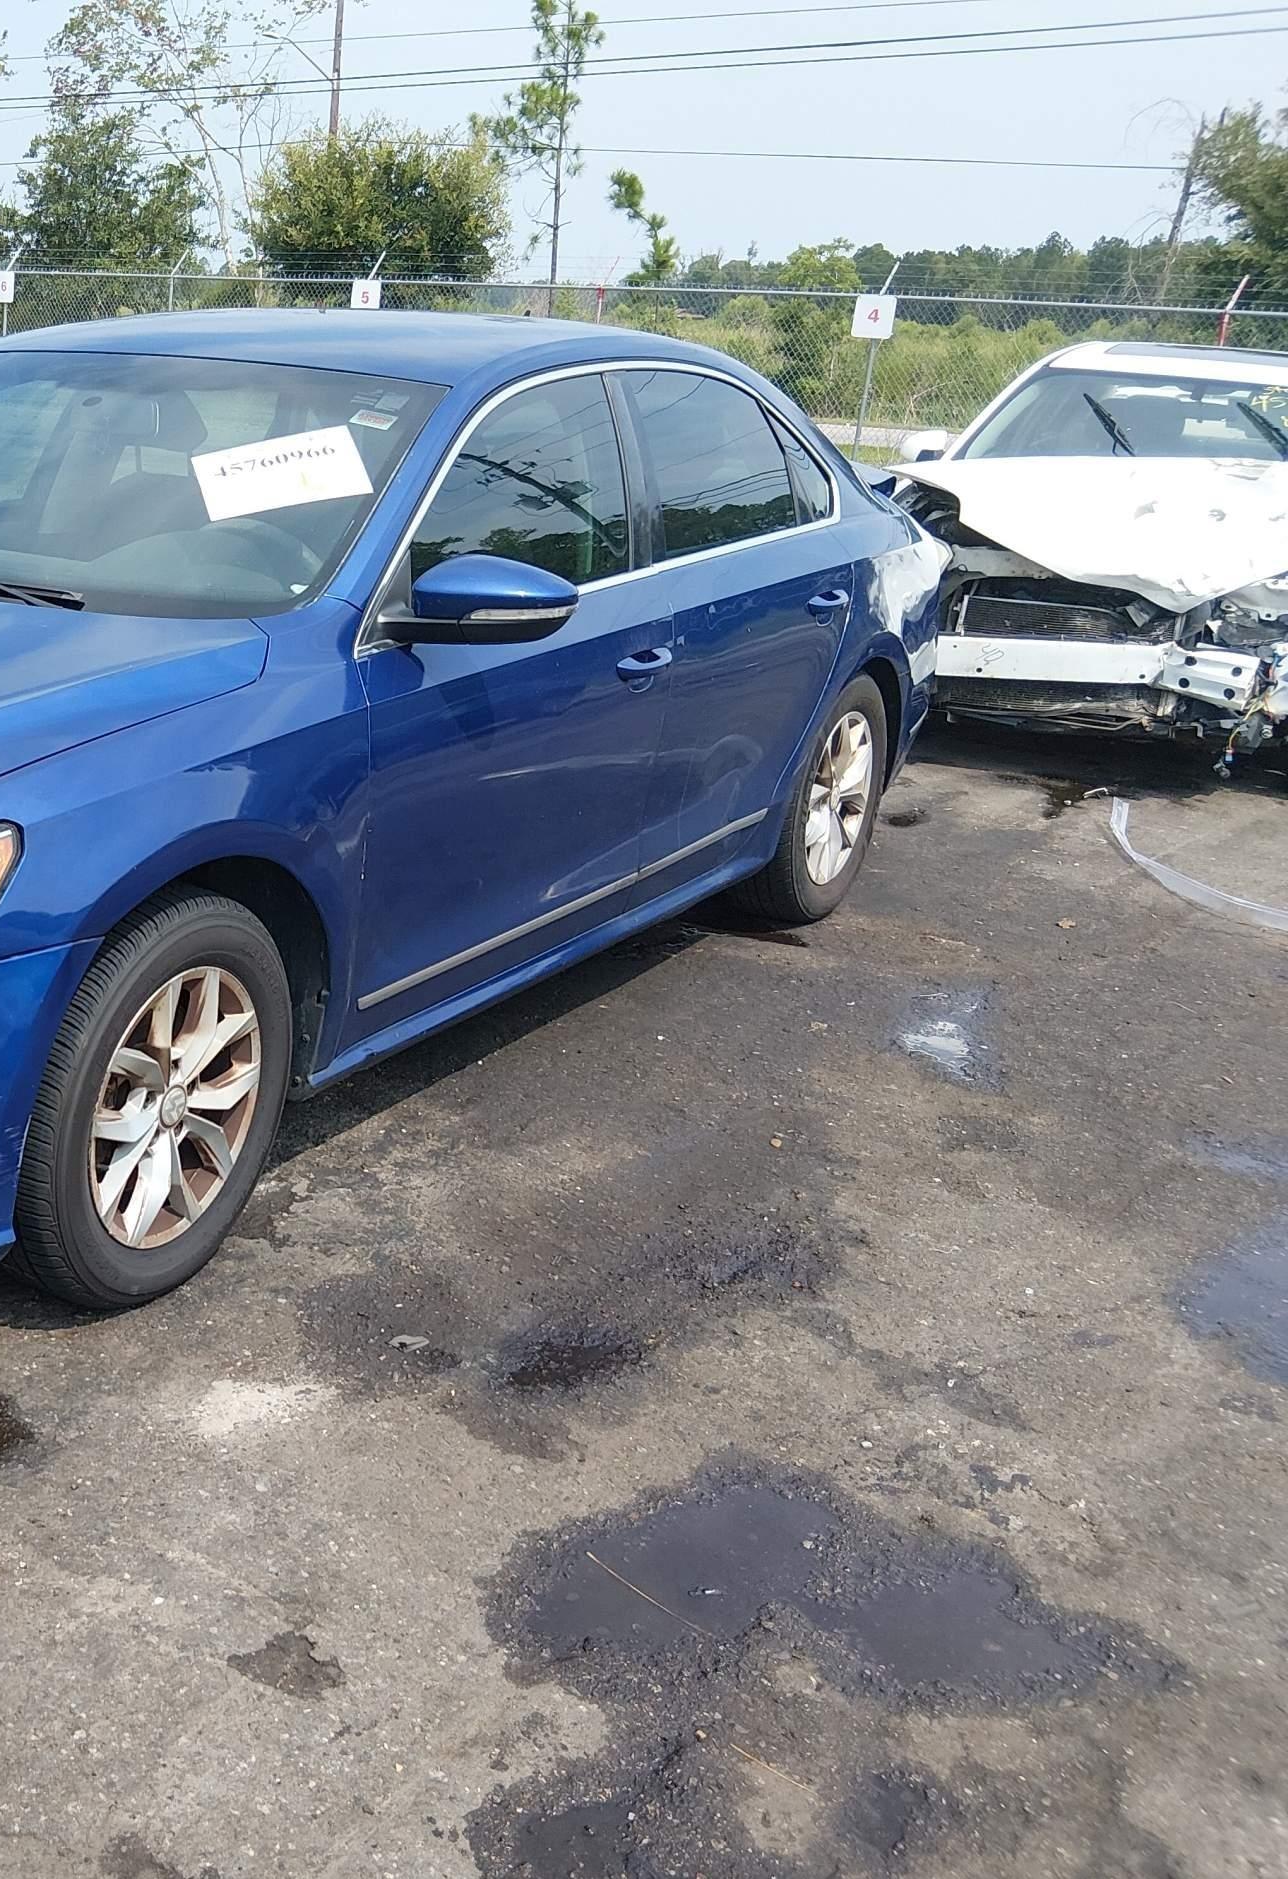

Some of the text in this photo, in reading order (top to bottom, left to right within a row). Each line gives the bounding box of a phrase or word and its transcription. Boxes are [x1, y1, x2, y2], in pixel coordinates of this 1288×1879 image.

[0, 281, 7, 292] 6
[360, 291, 370, 305] 5
[867, 308, 880, 323] 4
